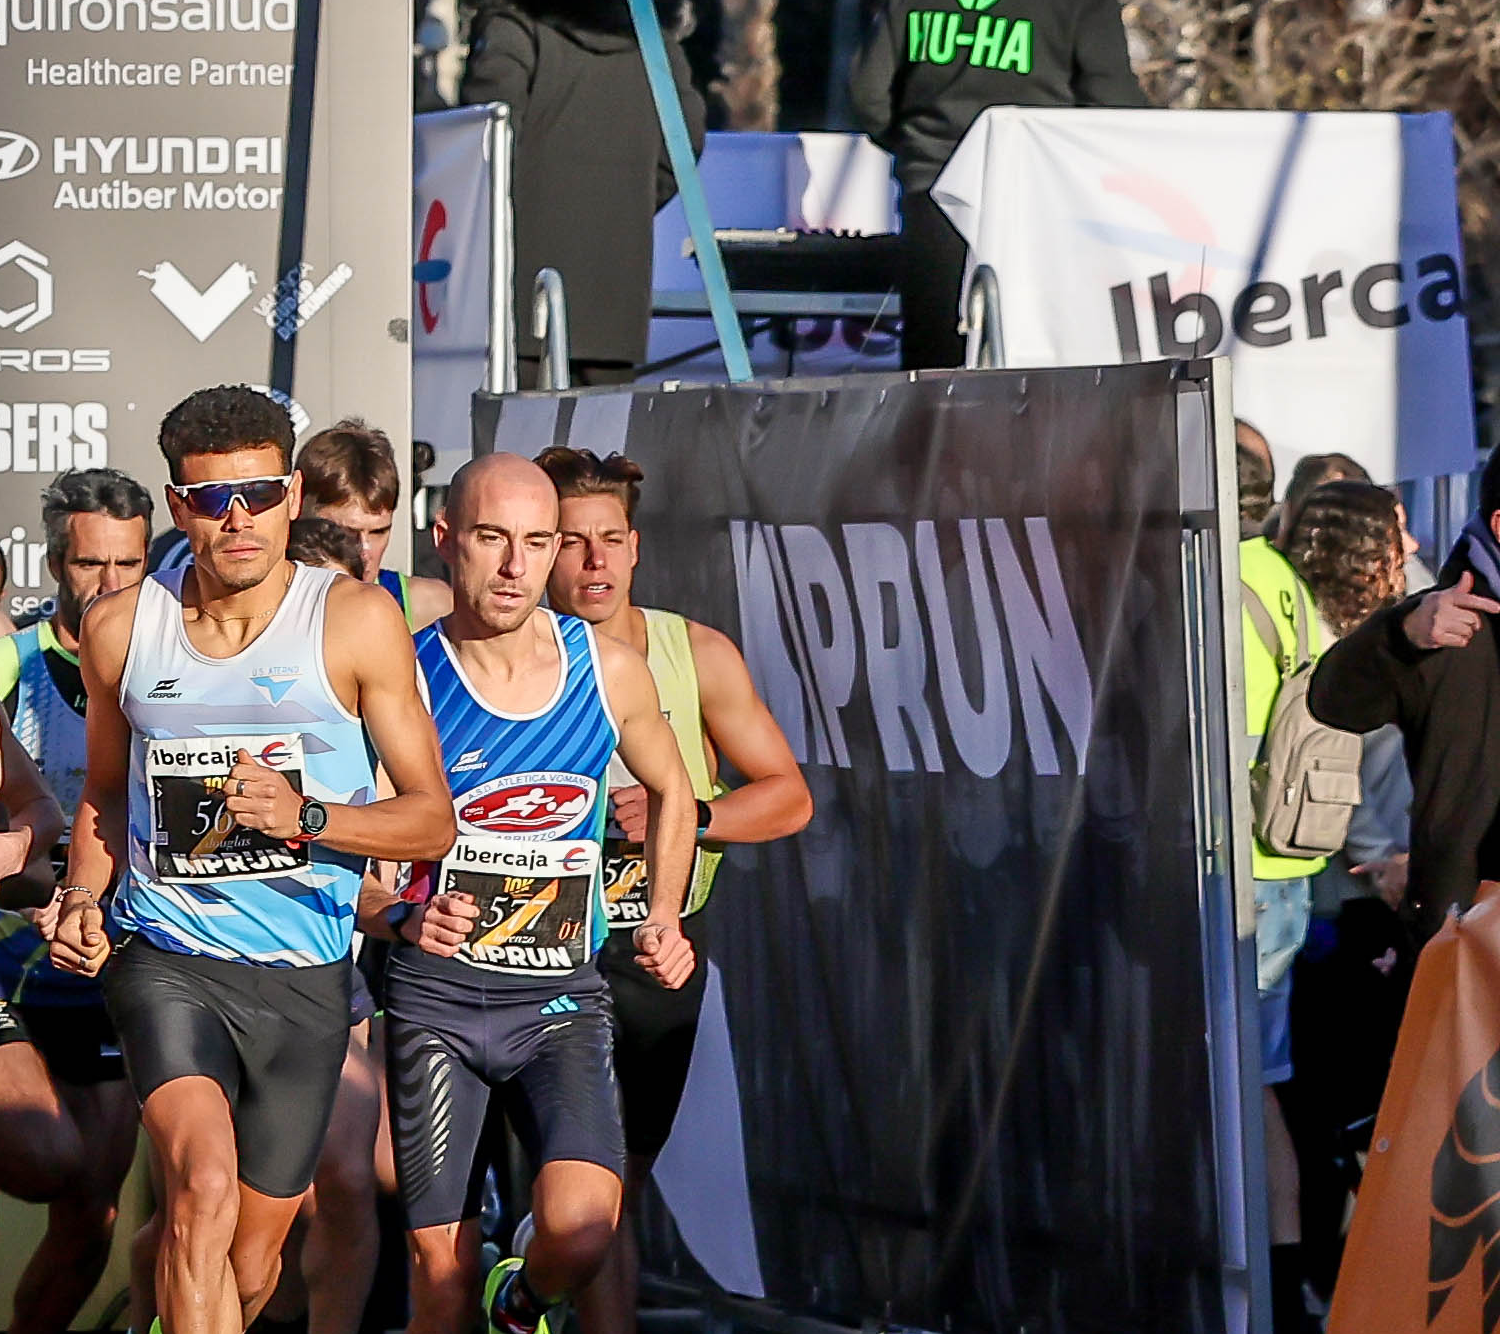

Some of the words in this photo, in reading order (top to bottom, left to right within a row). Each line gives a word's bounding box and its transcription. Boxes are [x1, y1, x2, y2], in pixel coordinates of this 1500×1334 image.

[26, 58, 182, 87] Healthcare
[190, 58, 297, 87] Partner
[53, 136, 282, 175] HYUNDAI
[53, 181, 178, 211] Autiber
[183, 182, 284, 211] Motor
[728, 515, 1092, 779] KIPRUN
[497, 774, 546, 787] ATLETICA
[549, 774, 591, 787] VOMANO
[205, 836, 251, 849] douglas
[171, 848, 298, 875] KIPRUN
[456, 844, 549, 870] Ibercaja
[504, 877, 535, 894] 10K
[480, 896, 551, 931] 577
[493, 933, 536, 944] lorenzo
[558, 919, 581, 940] 01
